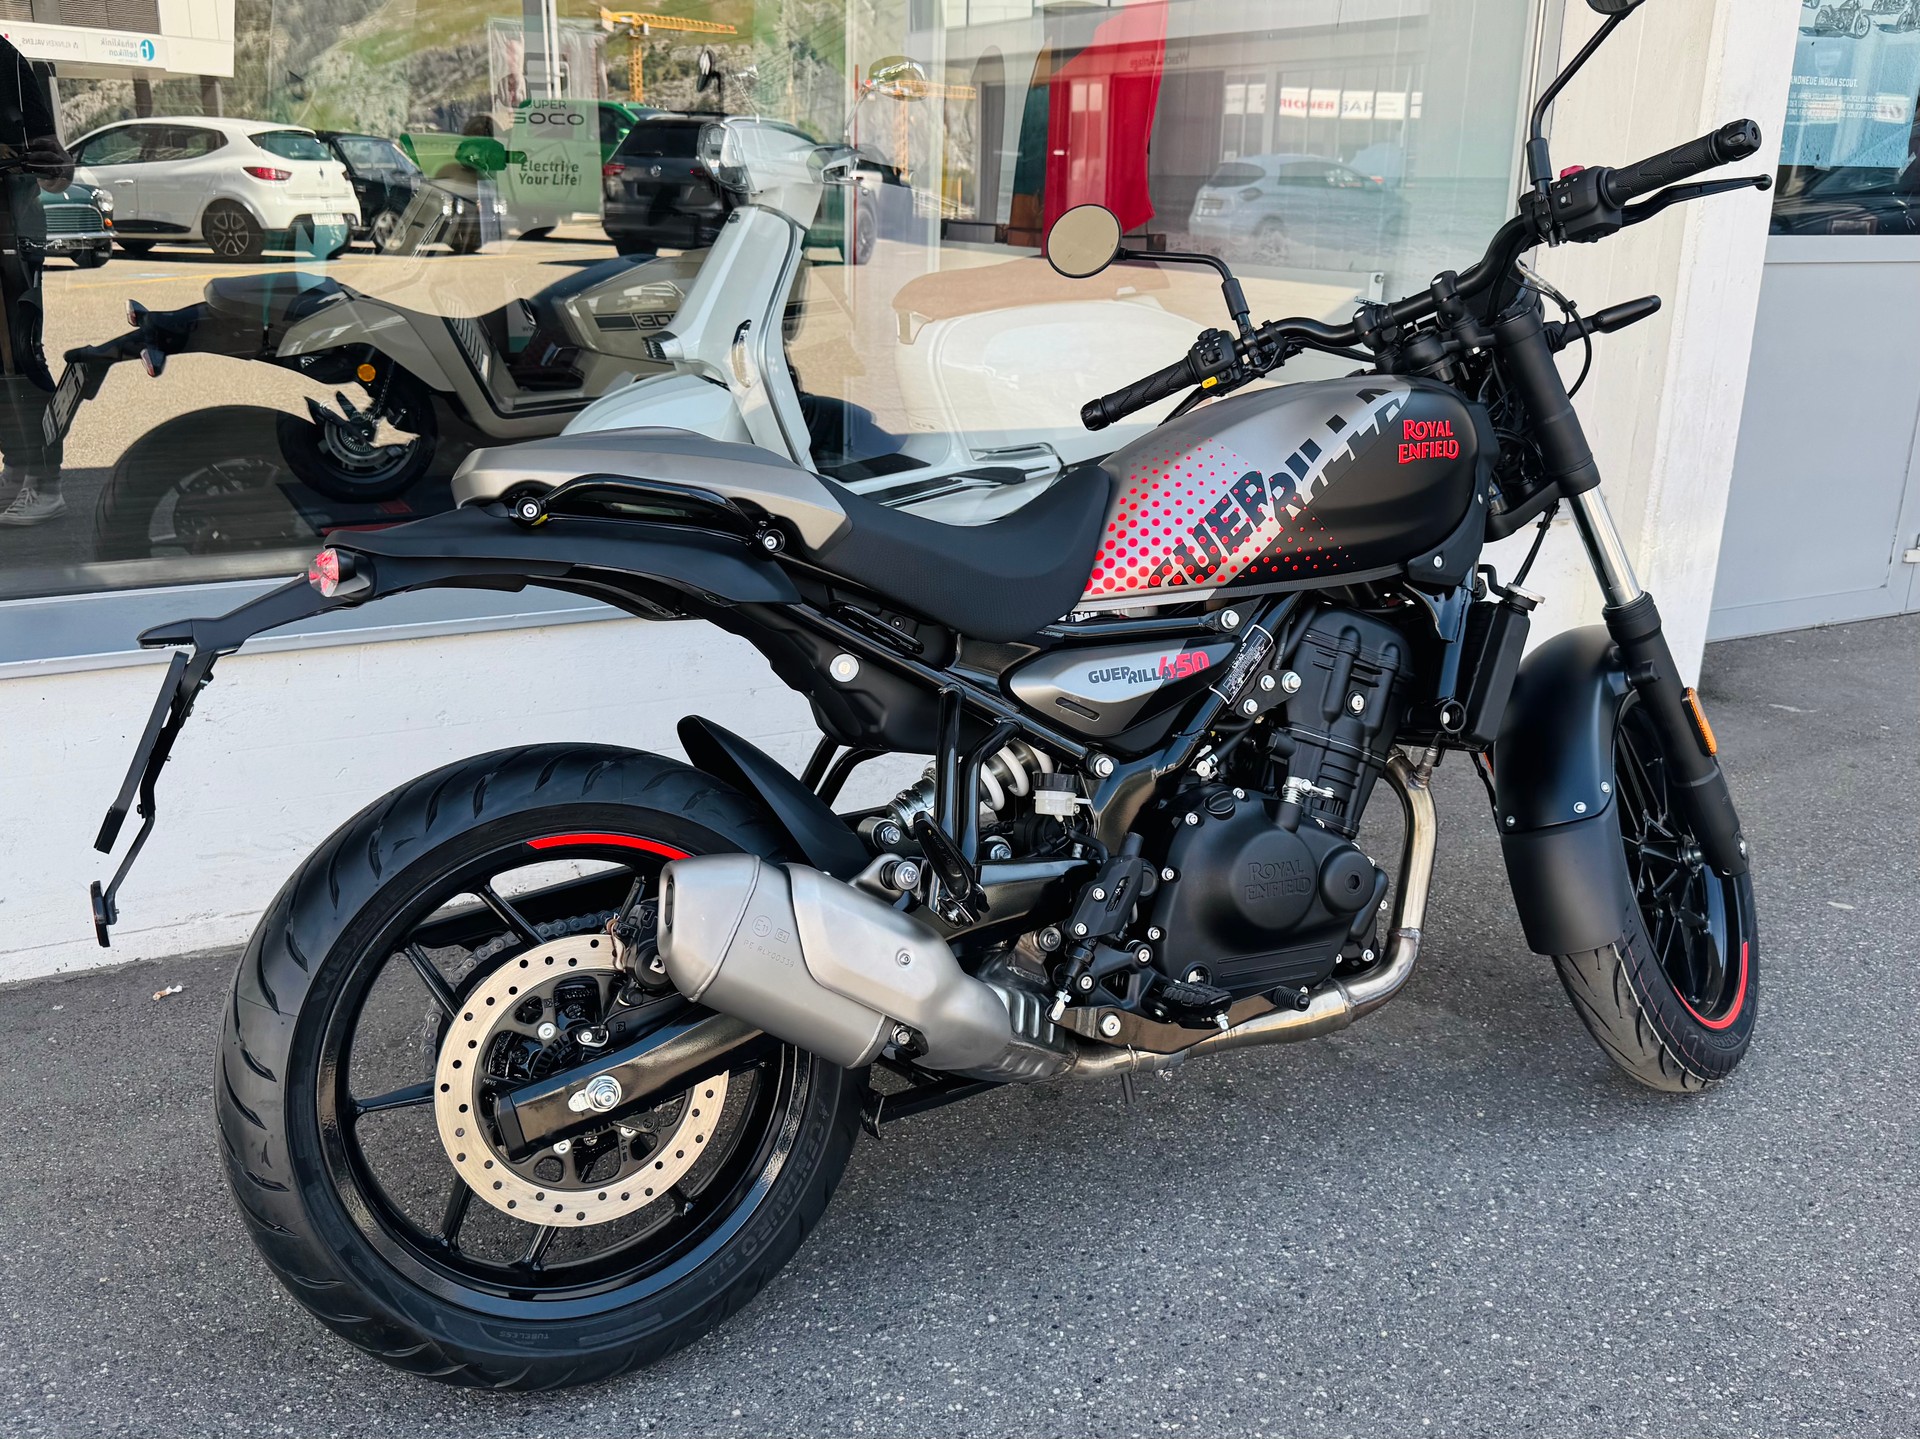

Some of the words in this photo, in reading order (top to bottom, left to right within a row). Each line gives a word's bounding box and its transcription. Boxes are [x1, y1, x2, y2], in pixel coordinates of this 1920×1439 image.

[1818, 76, 1838, 87] INDIAN
[509, 112, 584, 125] SOCO
[519, 173, 549, 185] Your
[636, 313, 676, 326] 30
[1402, 419, 1454, 440] ROYAL
[1398, 439, 1460, 464] ENFIELD
[1088, 665, 1173, 684] GUERRILLA
[1157, 651, 1210, 679] 450
[1247, 859, 1305, 880] ROYAL
[1244, 876, 1312, 901] ENFIELD
